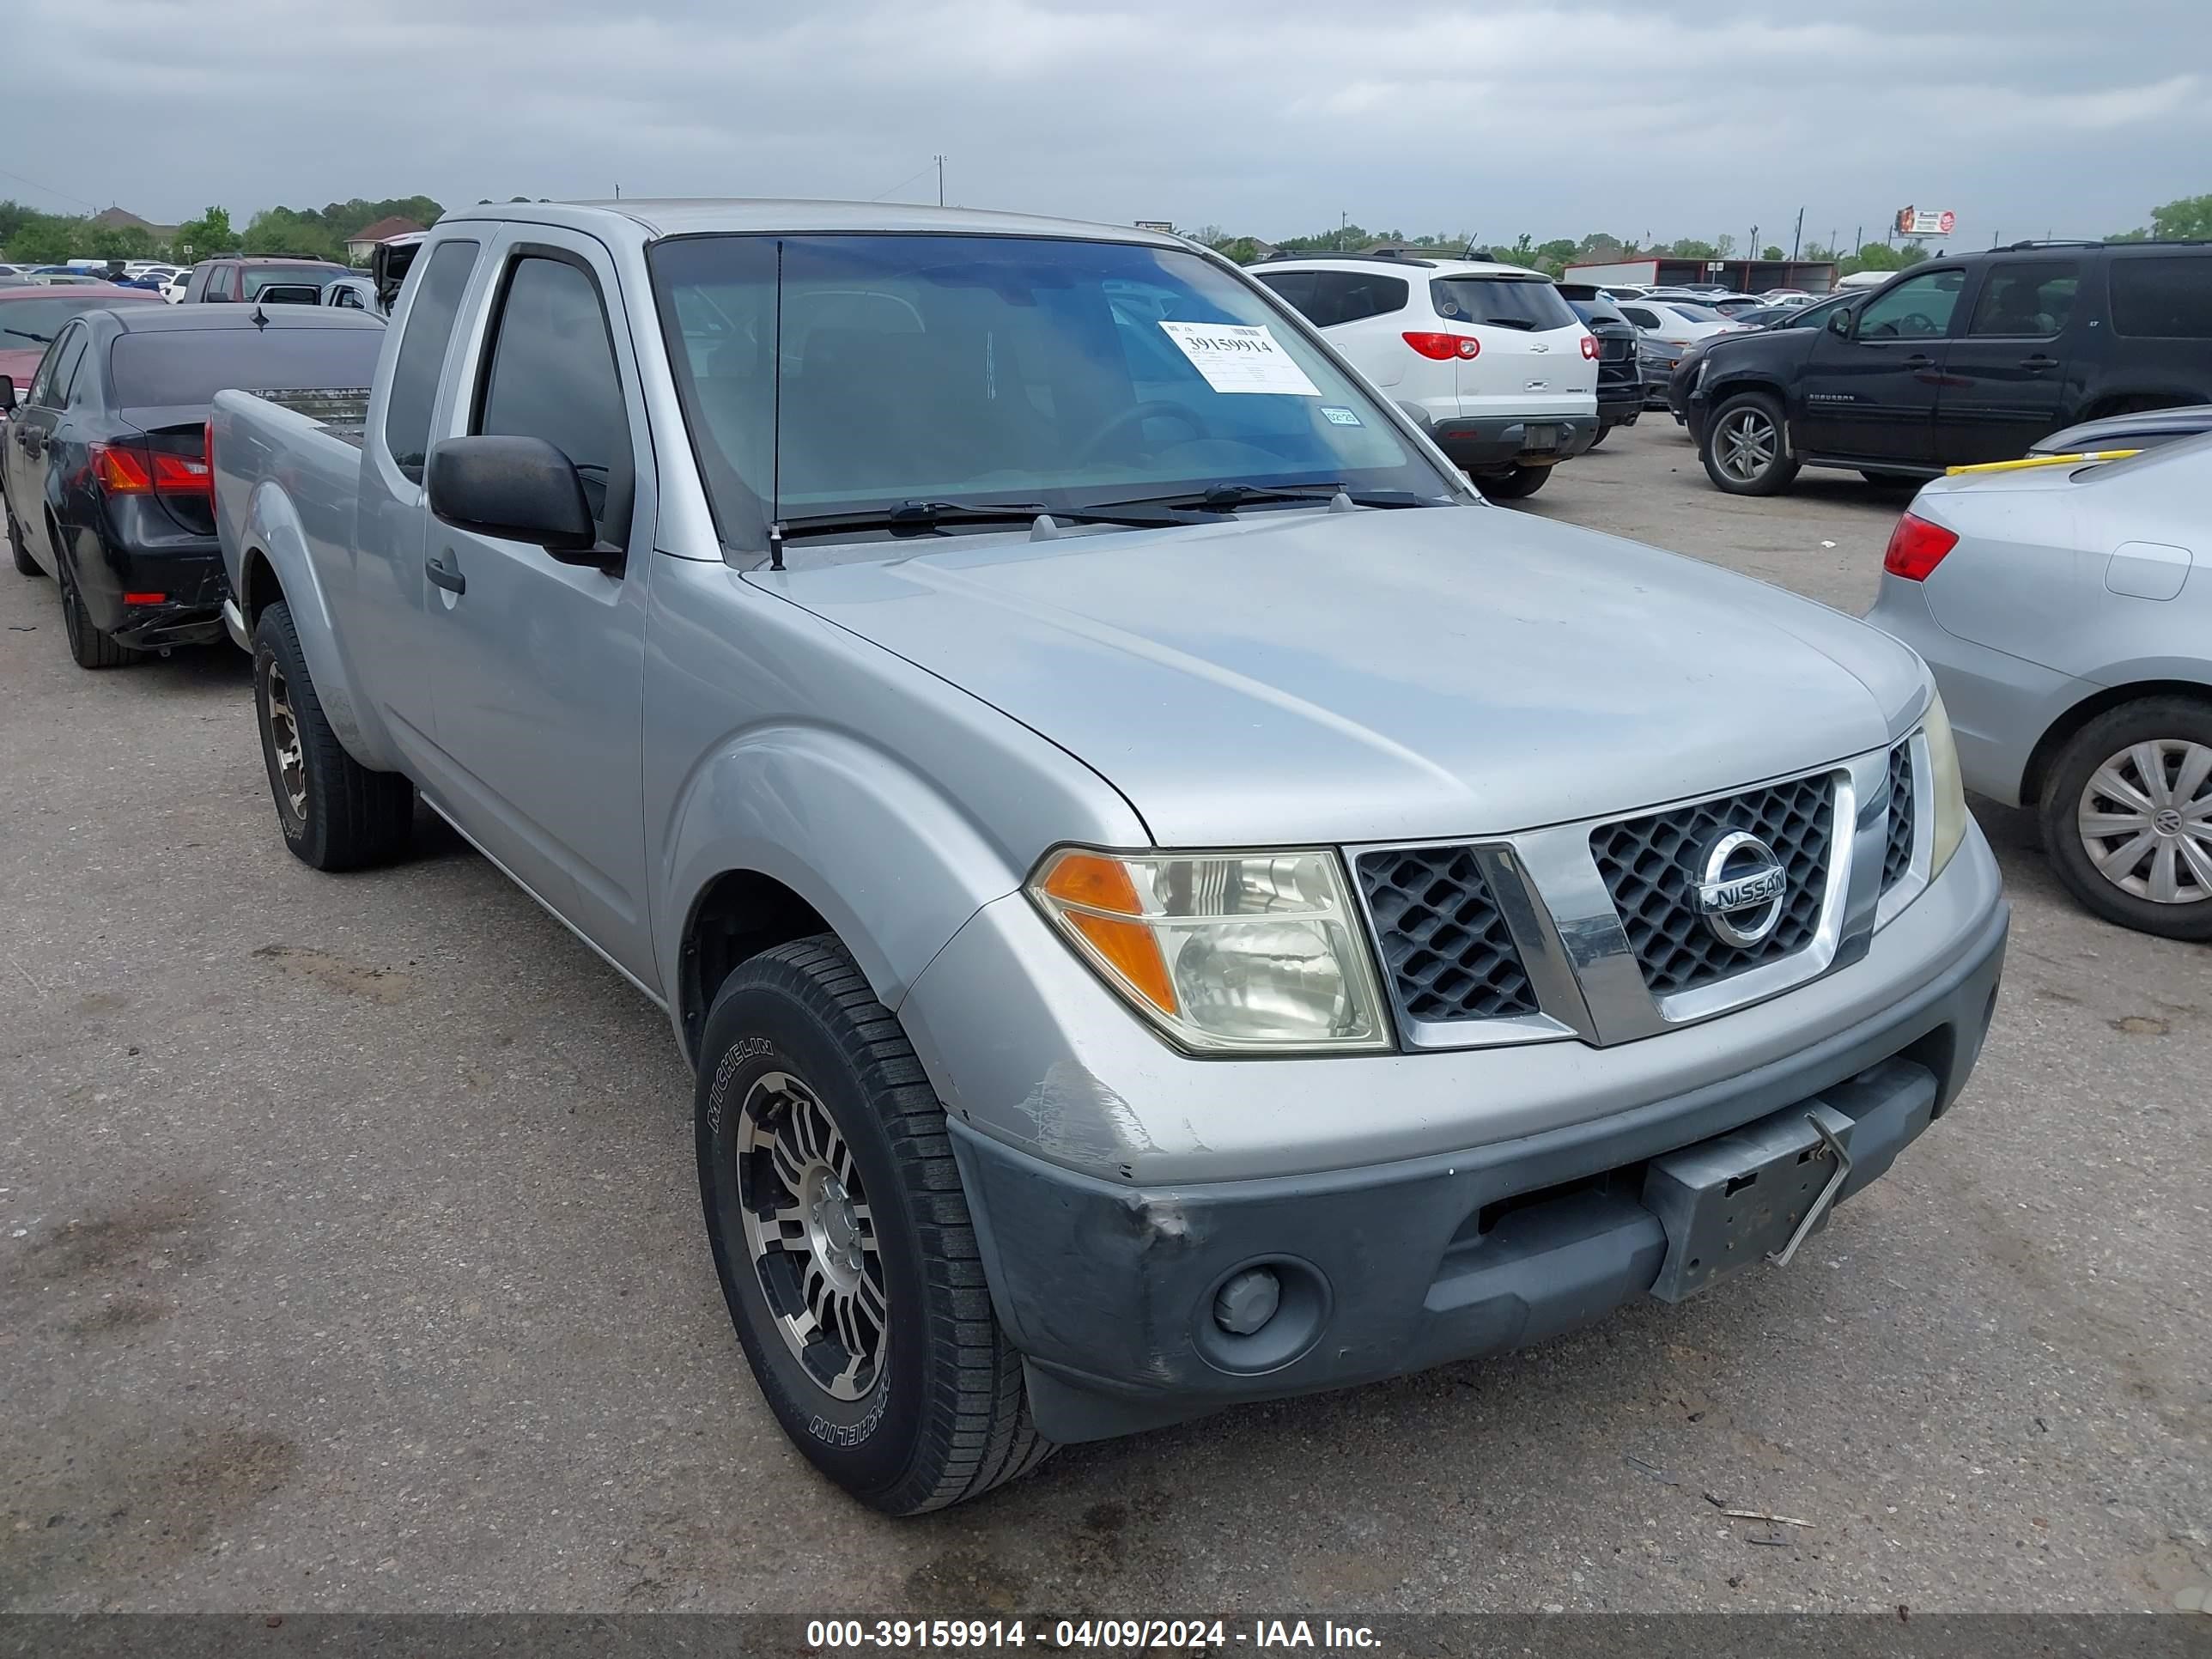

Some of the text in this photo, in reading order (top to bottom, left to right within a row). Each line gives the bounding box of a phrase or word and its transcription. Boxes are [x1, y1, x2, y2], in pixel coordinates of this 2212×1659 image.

[1185, 337, 1273, 353] 39159914
[1717, 870, 1784, 907] NISSAN
[707, 1036, 775, 1134] MICHELIN
